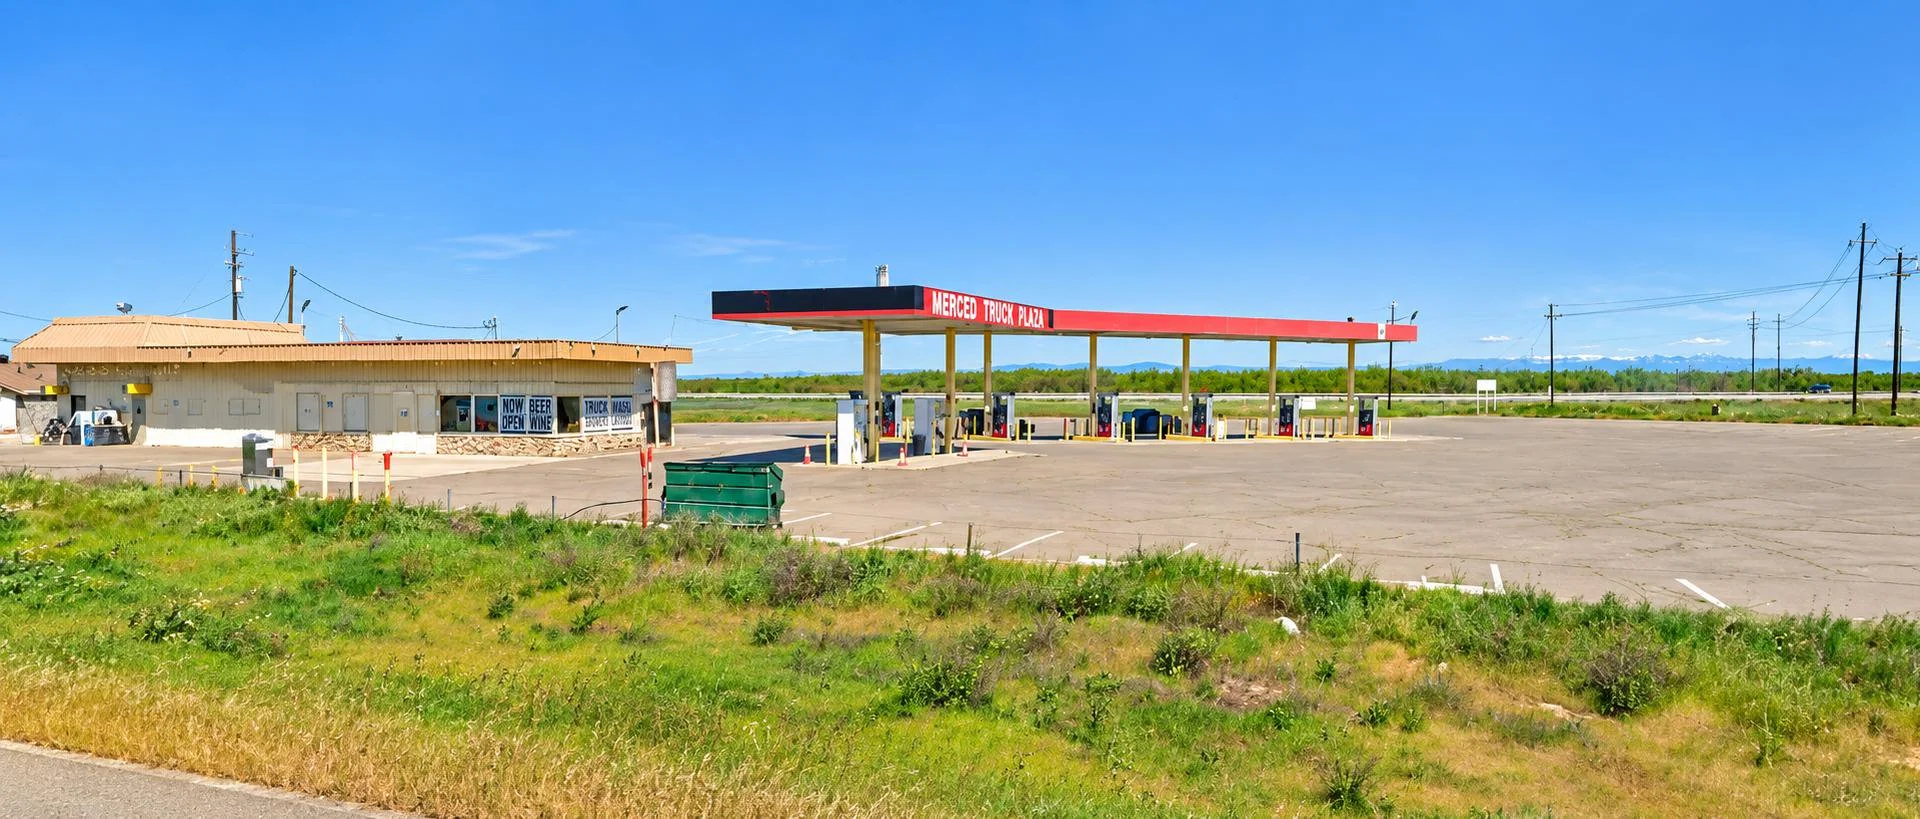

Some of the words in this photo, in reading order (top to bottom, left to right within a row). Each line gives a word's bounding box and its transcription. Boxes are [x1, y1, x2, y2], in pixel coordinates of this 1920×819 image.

[931, 290, 977, 320] MERCED
[983, 300, 1014, 325] TRUCK
[1018, 306, 1044, 328] PLAZA
[503, 398, 524, 413] NOW
[529, 399, 551, 414] BEER
[585, 400, 608, 414] TRUCK
[502, 414, 524, 430] OPEN
[529, 414, 552, 430] WINE
